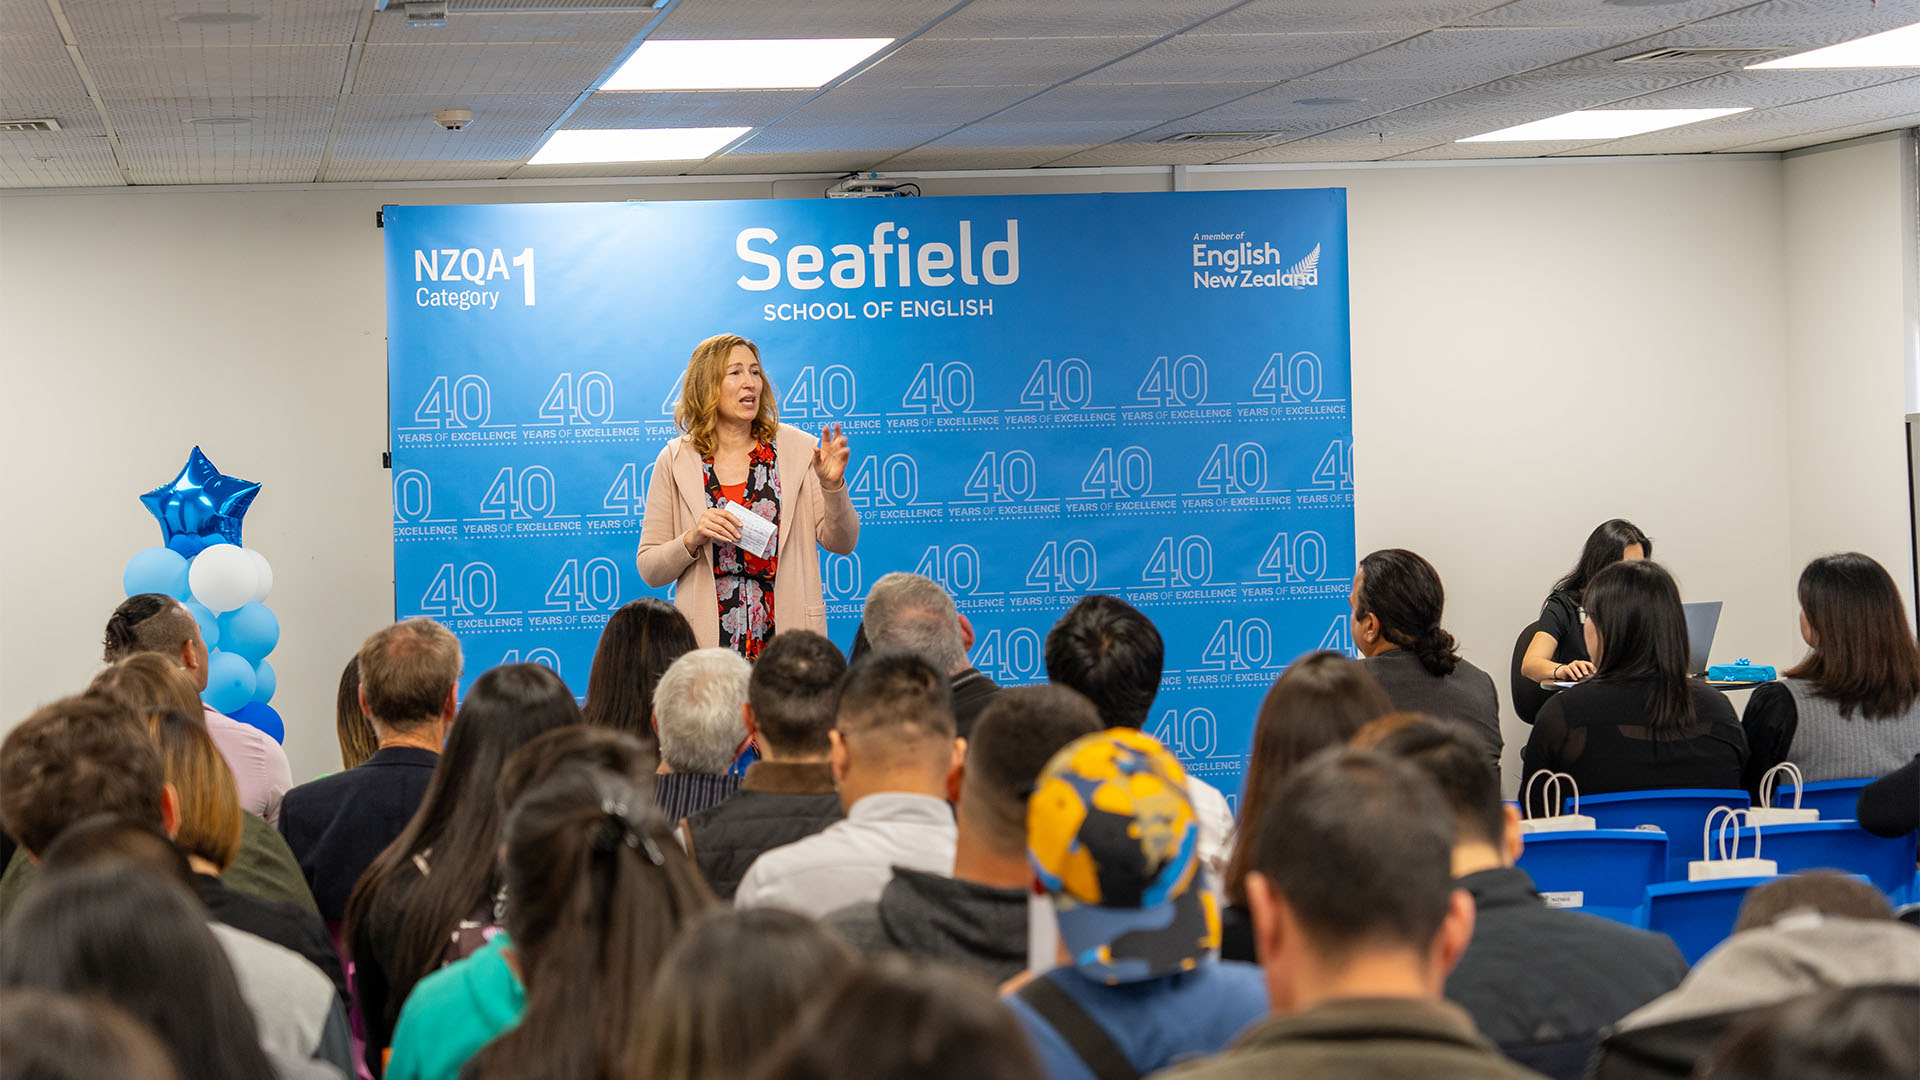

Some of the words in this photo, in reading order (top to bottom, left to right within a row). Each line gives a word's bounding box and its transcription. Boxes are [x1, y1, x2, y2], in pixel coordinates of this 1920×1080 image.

[1193, 233, 1200, 241] A
[1201, 232, 1233, 241] member
[1235, 231, 1246, 240] of
[736, 219, 1020, 291] Seafield
[1193, 242, 1280, 273] English
[415, 248, 510, 285] NZQA
[513, 248, 535, 306] 1
[1194, 271, 1238, 289] New
[1240, 269, 1318, 288] Zealand
[416, 287, 499, 310] Category
[763, 303, 856, 321] SCHOOL
[863, 301, 893, 318] OF
[901, 299, 993, 317] ENGLISH
[902, 361, 974, 414] 40
[1020, 358, 1092, 411] 40
[1137, 354, 1207, 407] 40
[1252, 351, 1322, 403] 40
[415, 374, 491, 429] 40
[539, 371, 614, 426] 40
[783, 364, 856, 418] 40
[887, 418, 919, 428] YEARS
[921, 417, 935, 426] OF
[937, 416, 999, 426] EXCELLENCE
[1004, 414, 1037, 424] YEARS
[1039, 413, 1052, 422] OF
[1054, 412, 1116, 422] EXCELLENCE
[1121, 411, 1153, 421] YEARS
[1155, 410, 1168, 419] OF
[1171, 409, 1232, 419] EXCELLENCE
[1237, 407, 1268, 417] YEARS
[1270, 406, 1284, 416] OF
[1286, 405, 1346, 415] EXCELLENCE
[398, 433, 432, 443] YEARS
[435, 432, 448, 441] OF
[451, 431, 517, 441] EXCELLENCE
[522, 430, 556, 439] YEARS
[558, 429, 572, 438] OF
[575, 427, 639, 437] EXCELLENCE
[802, 422, 815, 430] OF
[965, 449, 1036, 503] 40
[1081, 446, 1152, 499] 40
[1197, 441, 1267, 494] 40
[1312, 440, 1354, 490] 4
[480, 465, 555, 520] 40
[850, 453, 918, 507] 40
[394, 469, 431, 524] 0
[1066, 503, 1098, 512] YEARS
[1100, 502, 1113, 511] OF
[1115, 500, 1177, 511] EXCELLENCE
[1182, 498, 1214, 508] YEARS
[1215, 498, 1228, 507] OF
[1231, 495, 1291, 507] EXCELLENCE
[1297, 495, 1328, 503] YEARS
[1330, 494, 1342, 502] OF
[587, 519, 620, 529] YEARS
[623, 519, 636, 528] OF
[864, 511, 878, 519] OF
[880, 508, 943, 519] EXCELLENCE
[948, 506, 981, 517] YEARS
[982, 506, 996, 515] OF
[998, 504, 1060, 515] EXCELLENCE
[394, 525, 457, 536] EXCELLENCE
[464, 524, 497, 534] YEARS
[500, 523, 513, 532] OF
[516, 521, 581, 531] EXCELLENCE
[1026, 539, 1097, 592] 40
[1143, 535, 1212, 588] 40
[1257, 531, 1326, 584] 40
[421, 561, 497, 617] 40
[545, 557, 620, 612] 40
[818, 551, 861, 601] 0
[954, 598, 1004, 608] CELLENCE
[1010, 597, 1042, 606] YEARS
[1044, 596, 1057, 604] OF
[1127, 591, 1158, 601] YEARS
[1160, 590, 1173, 599] OF
[1176, 589, 1237, 599] EXCELLENCE
[1242, 587, 1273, 596] YEARS
[1275, 586, 1288, 595] OF
[1290, 584, 1350, 594] EXCELLENCE
[529, 616, 562, 625] YEARS
[565, 615, 578, 624] OF
[581, 614, 610, 624] EXCEL
[826, 604, 864, 613] EXCELLE
[457, 617, 523, 628] EXCELLENCE
[1202, 617, 1272, 671] 40
[1317, 615, 1357, 658] 4
[971, 627, 1041, 680] 40
[1186, 675, 1218, 684] YEARS
[1220, 674, 1233, 682] OF
[1236, 672, 1282, 681] EXCELLEN
[1153, 707, 1217, 760] 40
